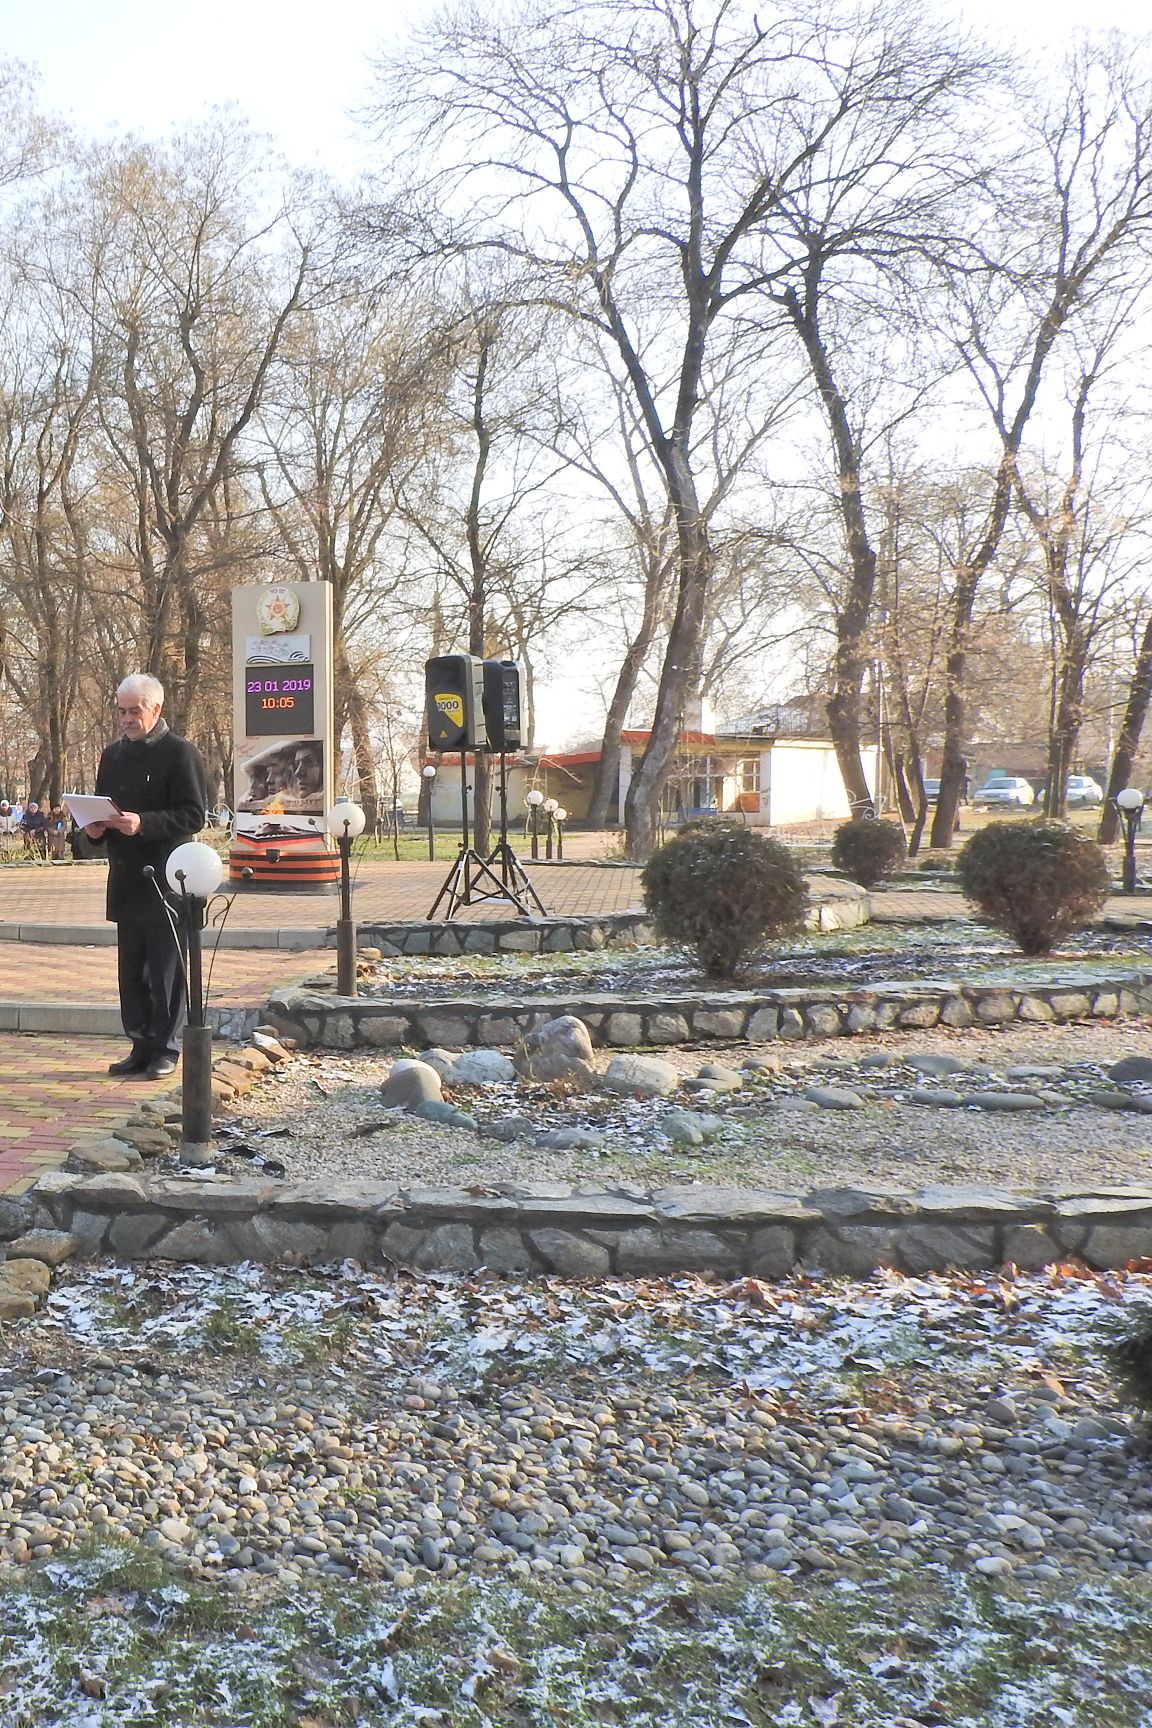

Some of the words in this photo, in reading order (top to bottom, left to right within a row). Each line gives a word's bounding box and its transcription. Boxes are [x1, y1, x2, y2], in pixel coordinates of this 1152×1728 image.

[247, 681, 261, 693] 23
[264, 681, 279, 692] 01
[282, 679, 311, 691] 2019
[261, 696, 295, 709] 10:05
